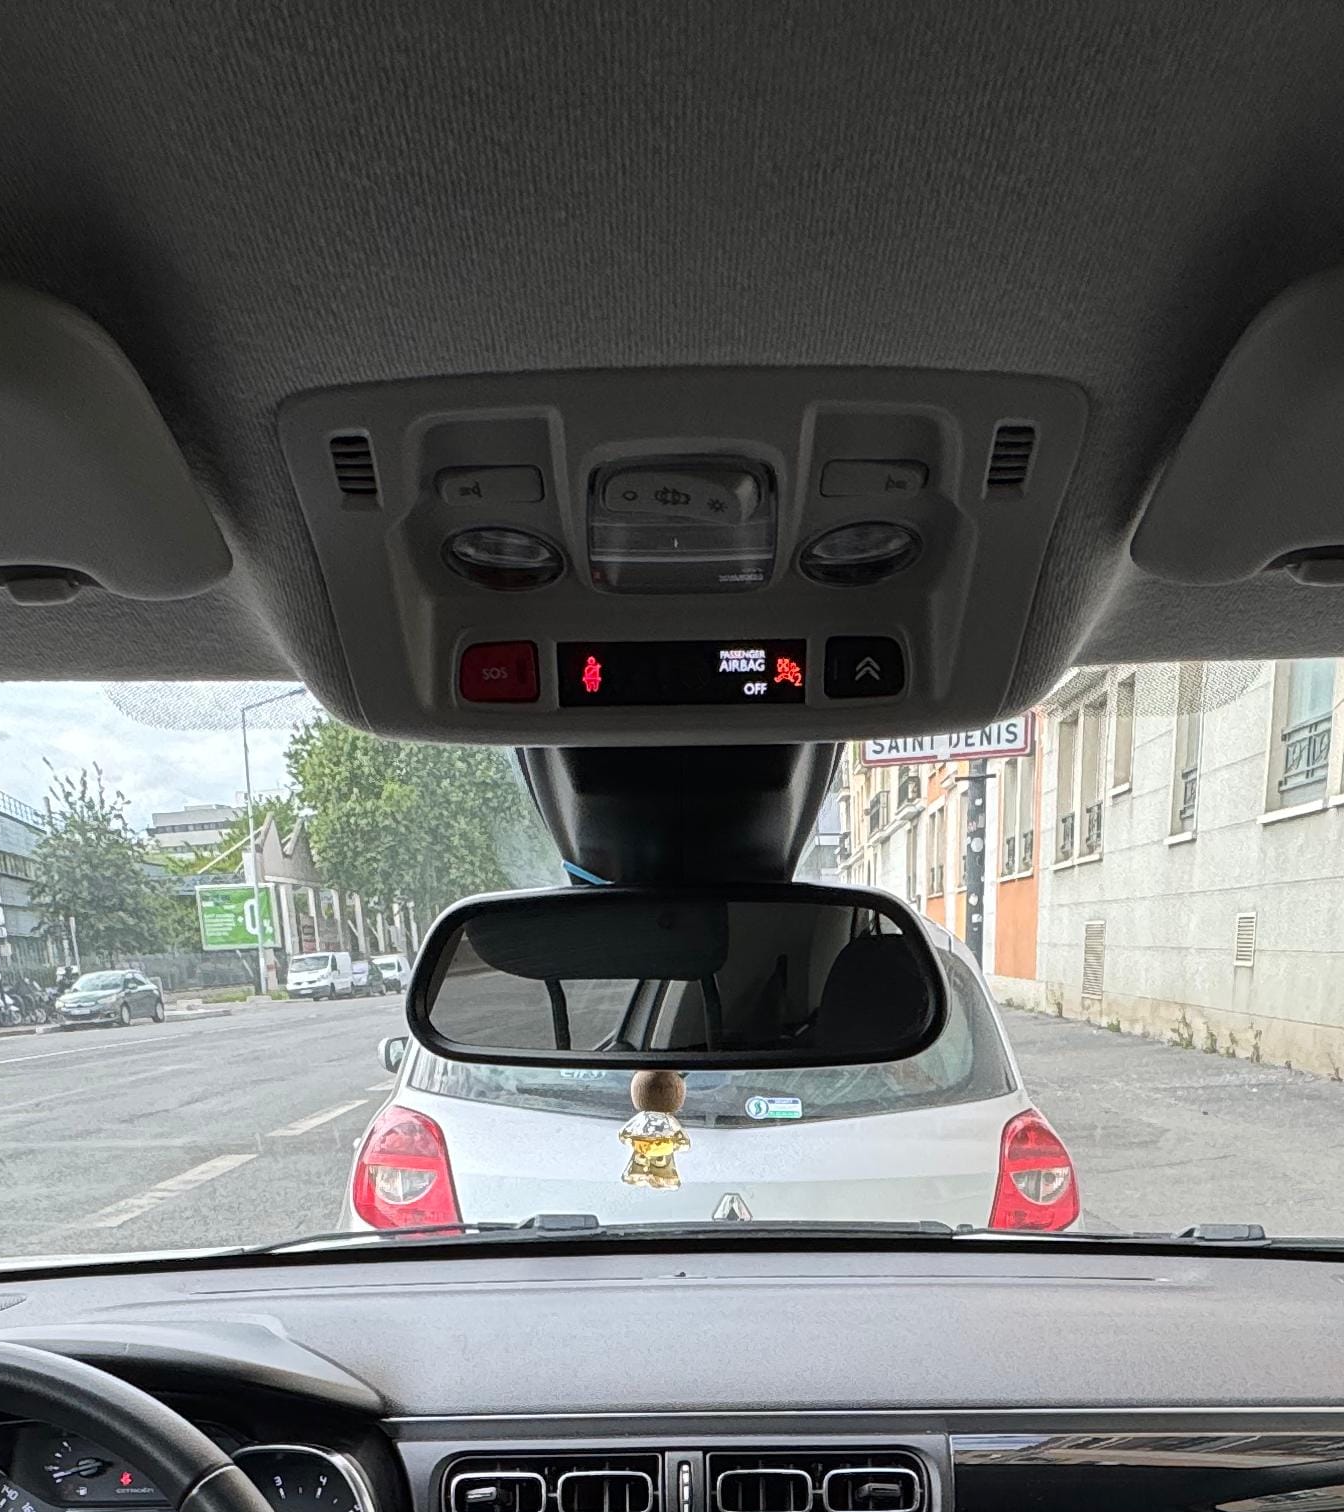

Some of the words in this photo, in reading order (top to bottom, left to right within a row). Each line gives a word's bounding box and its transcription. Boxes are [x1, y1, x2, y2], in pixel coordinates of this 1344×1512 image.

[719, 650, 766, 659] PASSENGER
[719, 659, 765, 673] AIRBAG
[482, 667, 508, 680] SOS
[743, 682, 768, 696] OFF
[872, 736, 935, 755] SAINT
[949, 723, 1018, 749] DENIS
[273, 1475, 283, 1486] 3
[319, 1475, 328, 1486] 4
[1, 1484, 19, 1501] 140
